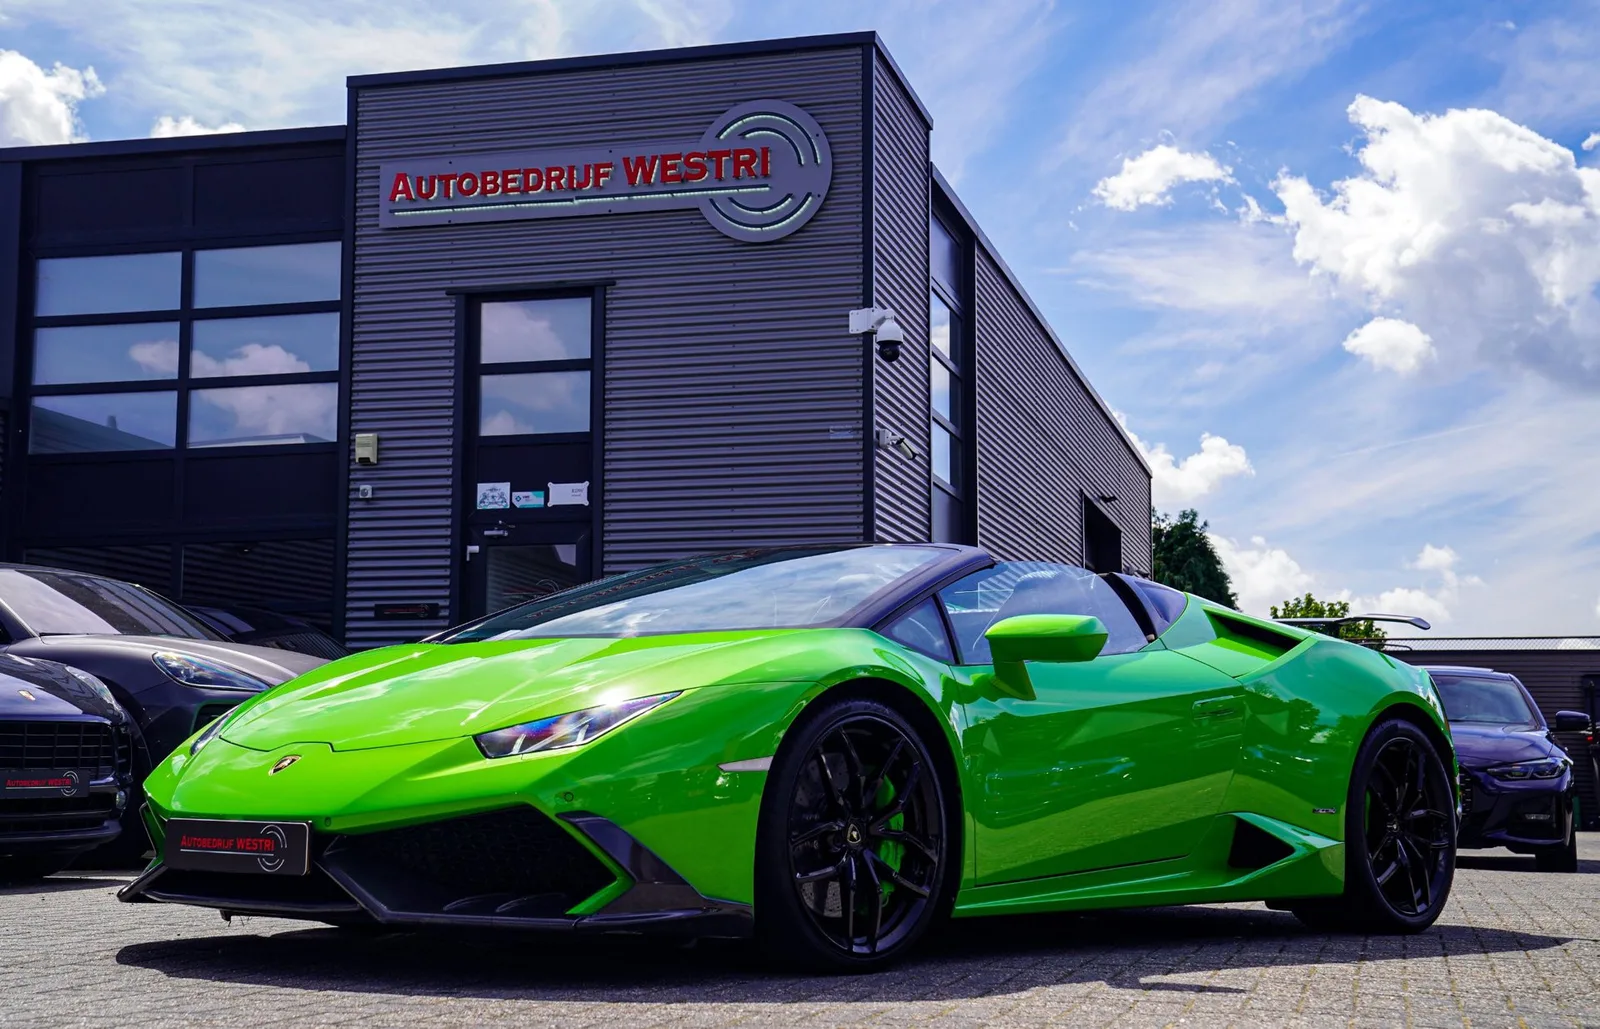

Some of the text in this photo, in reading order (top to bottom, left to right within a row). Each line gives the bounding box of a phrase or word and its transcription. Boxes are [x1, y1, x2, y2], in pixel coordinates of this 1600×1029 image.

[388, 147, 771, 202] AUTOBEDRIJF WESTRI
[180, 835, 275, 851] AUTOBEDRIJF WESTRI
